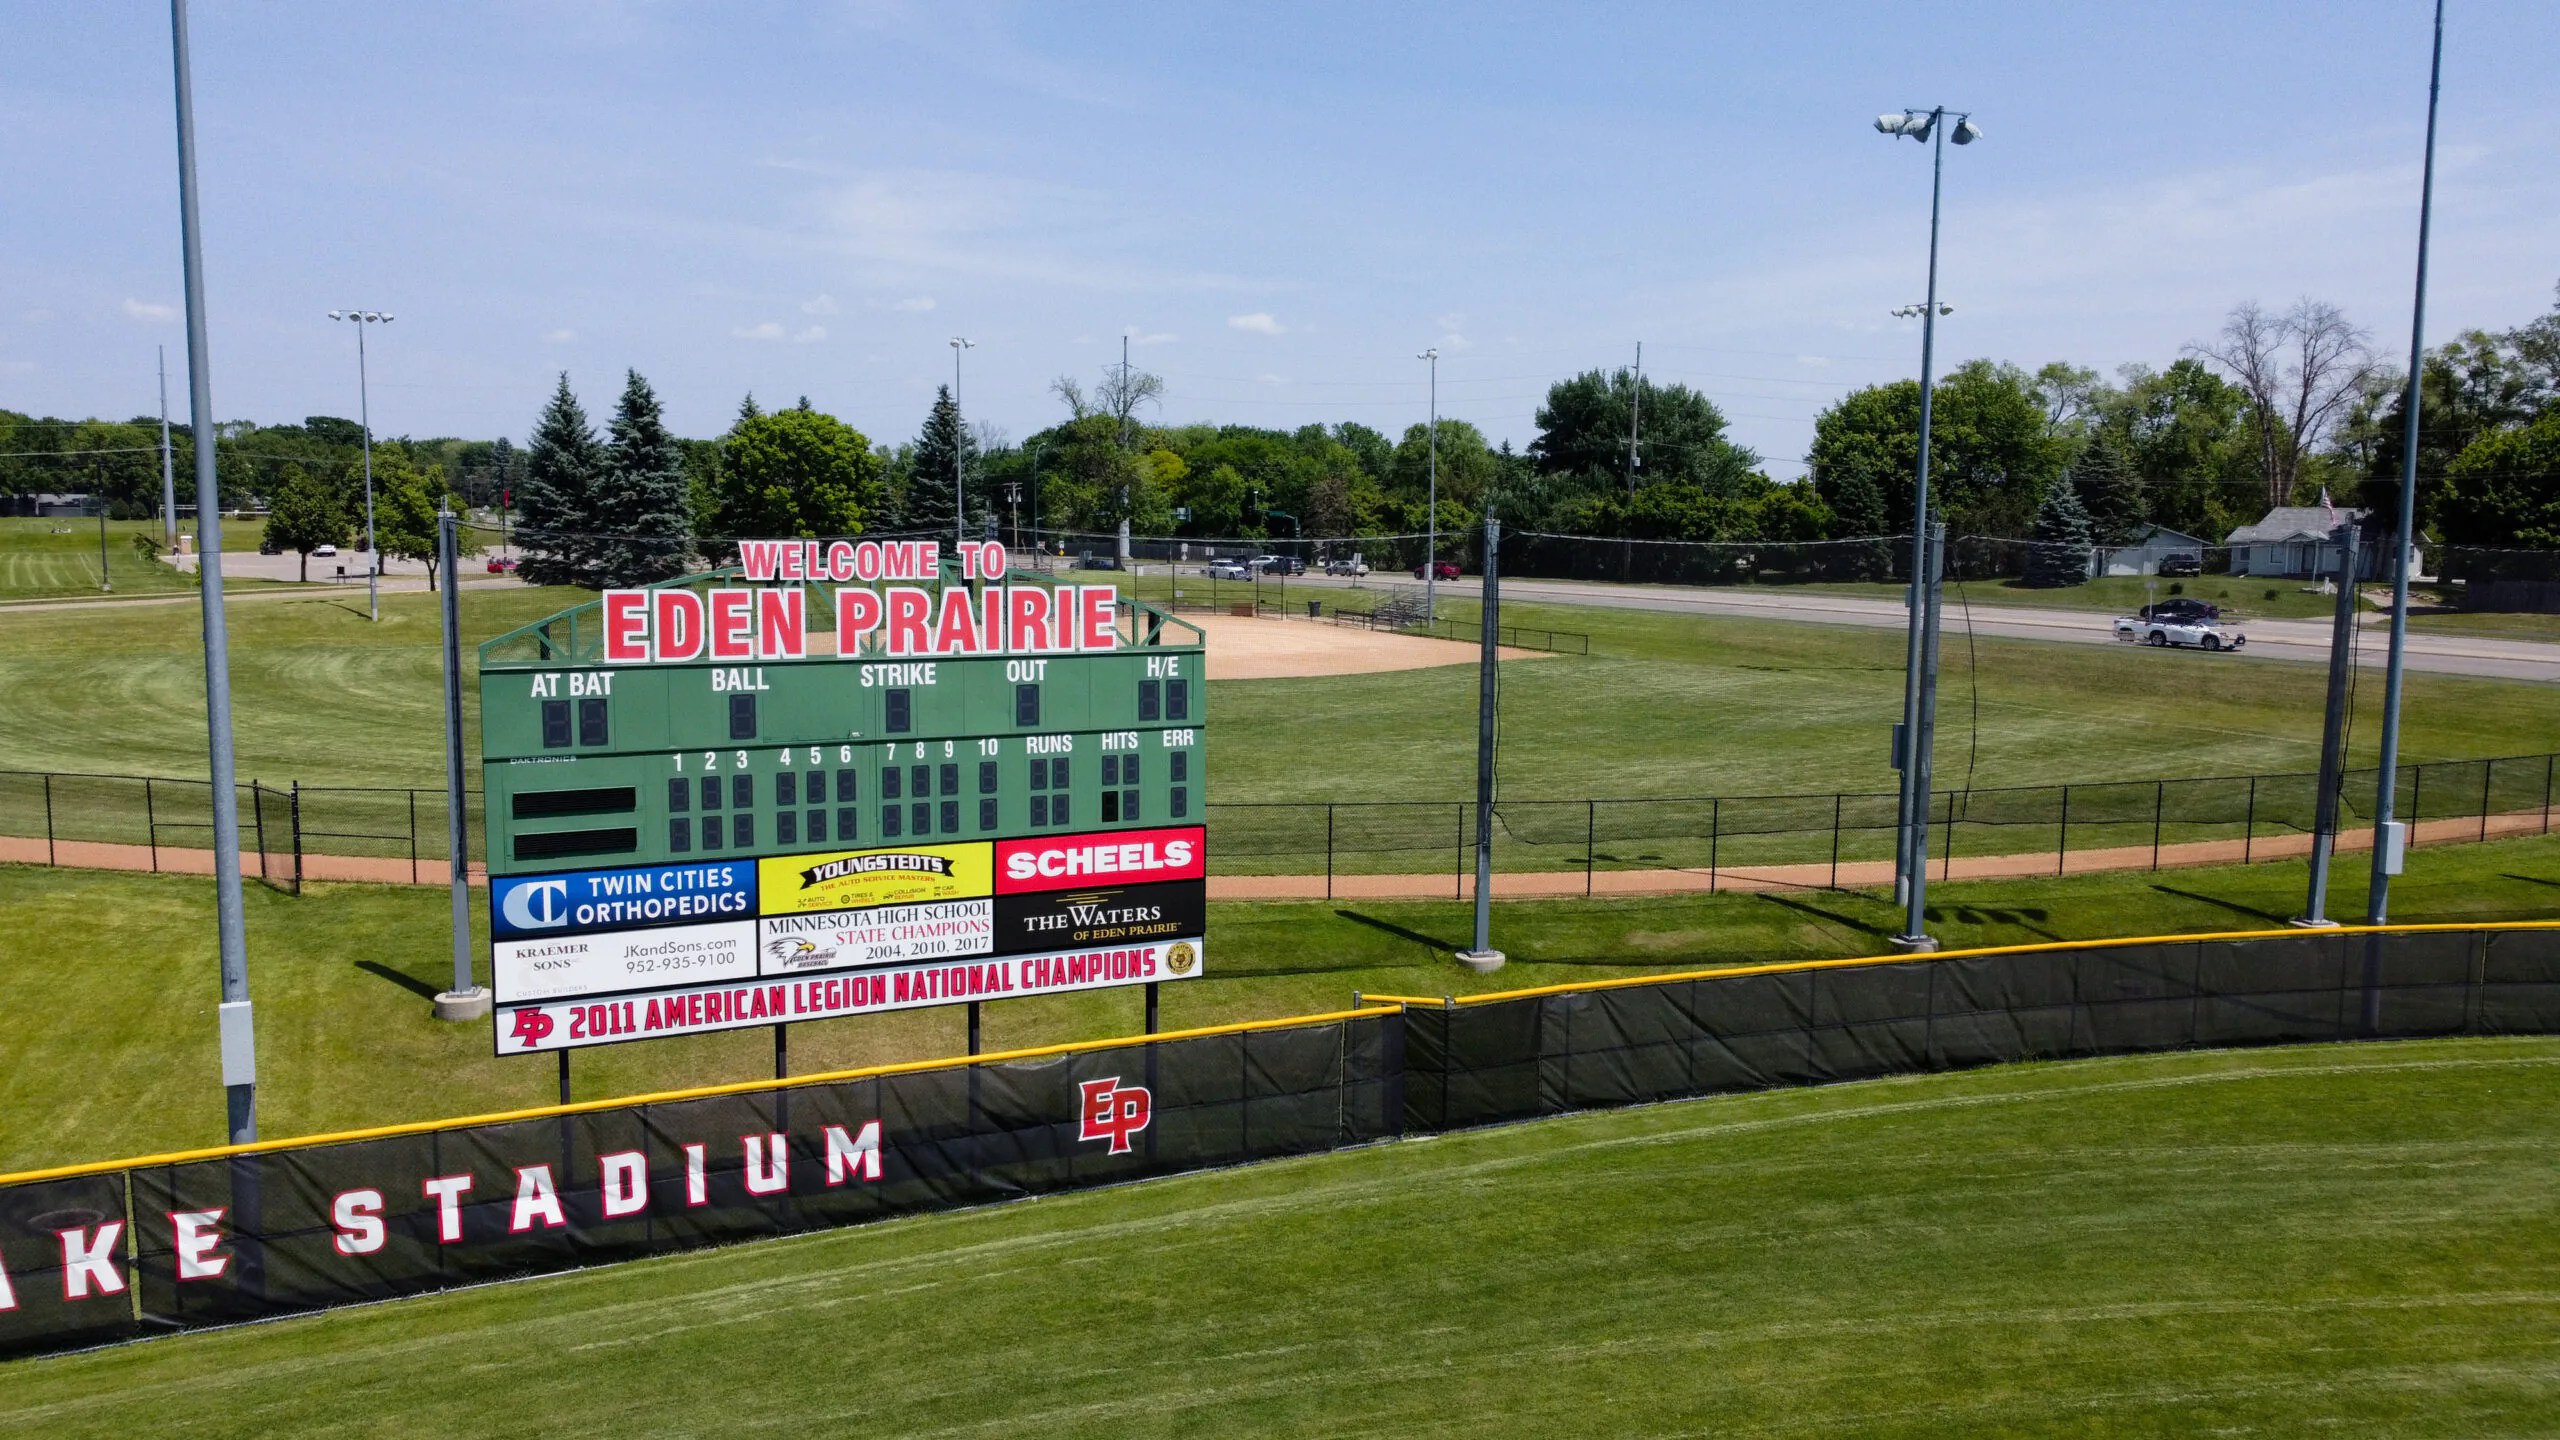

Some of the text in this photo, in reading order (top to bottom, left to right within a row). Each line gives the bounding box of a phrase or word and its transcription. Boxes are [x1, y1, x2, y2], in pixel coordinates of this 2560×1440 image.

[738, 541, 1006, 580] WELCOME TO
[603, 585, 1117, 664] EDEN PRAIRIE
[861, 663, 936, 687] STRIKE
[1006, 659, 1047, 682] OUT
[1147, 656, 1178, 677] H/E
[531, 671, 614, 698] AT BAT
[712, 668, 769, 691] BALL
[1027, 735, 1072, 754] RUNS
[1102, 732, 1138, 750] HITS
[1163, 729, 1194, 747] ERR
[673, 738, 998, 772] 1 2 3 4 5 6 7 8 9 10
[812, 855, 944, 882] YOUNGSTEDTS
[1006, 840, 1192, 879] SCHEELS
[588, 867, 733, 897] TWIN CITIES
[898, 874, 936, 882] MASTERS
[576, 891, 747, 925] ORTHOPEDICS
[769, 901, 990, 935] MINNESOTA HIGH SCHOOL
[836, 918, 990, 946] STATE CHAMPIONS
[1024, 914, 1068, 931] THE
[1073, 922, 1178, 940] OF EDEN PRAIRIE
[516, 944, 589, 958] KRAEMER
[623, 938, 737, 959] JKandSons.com
[866, 936, 989, 960] 2004, 2010, 2017
[533, 959, 571, 971] SONS
[626, 952, 735, 974] 952-935-9100
[570, 1001, 636, 1040] 2011
[644, 985, 786, 1031] AMERICAN
[794, 974, 886, 1014] LEGION
[894, 962, 1014, 1003] NATIONAL
[1021, 948, 1155, 990] CHAMPIONS
[331, 1119, 884, 1257] STADIUM
